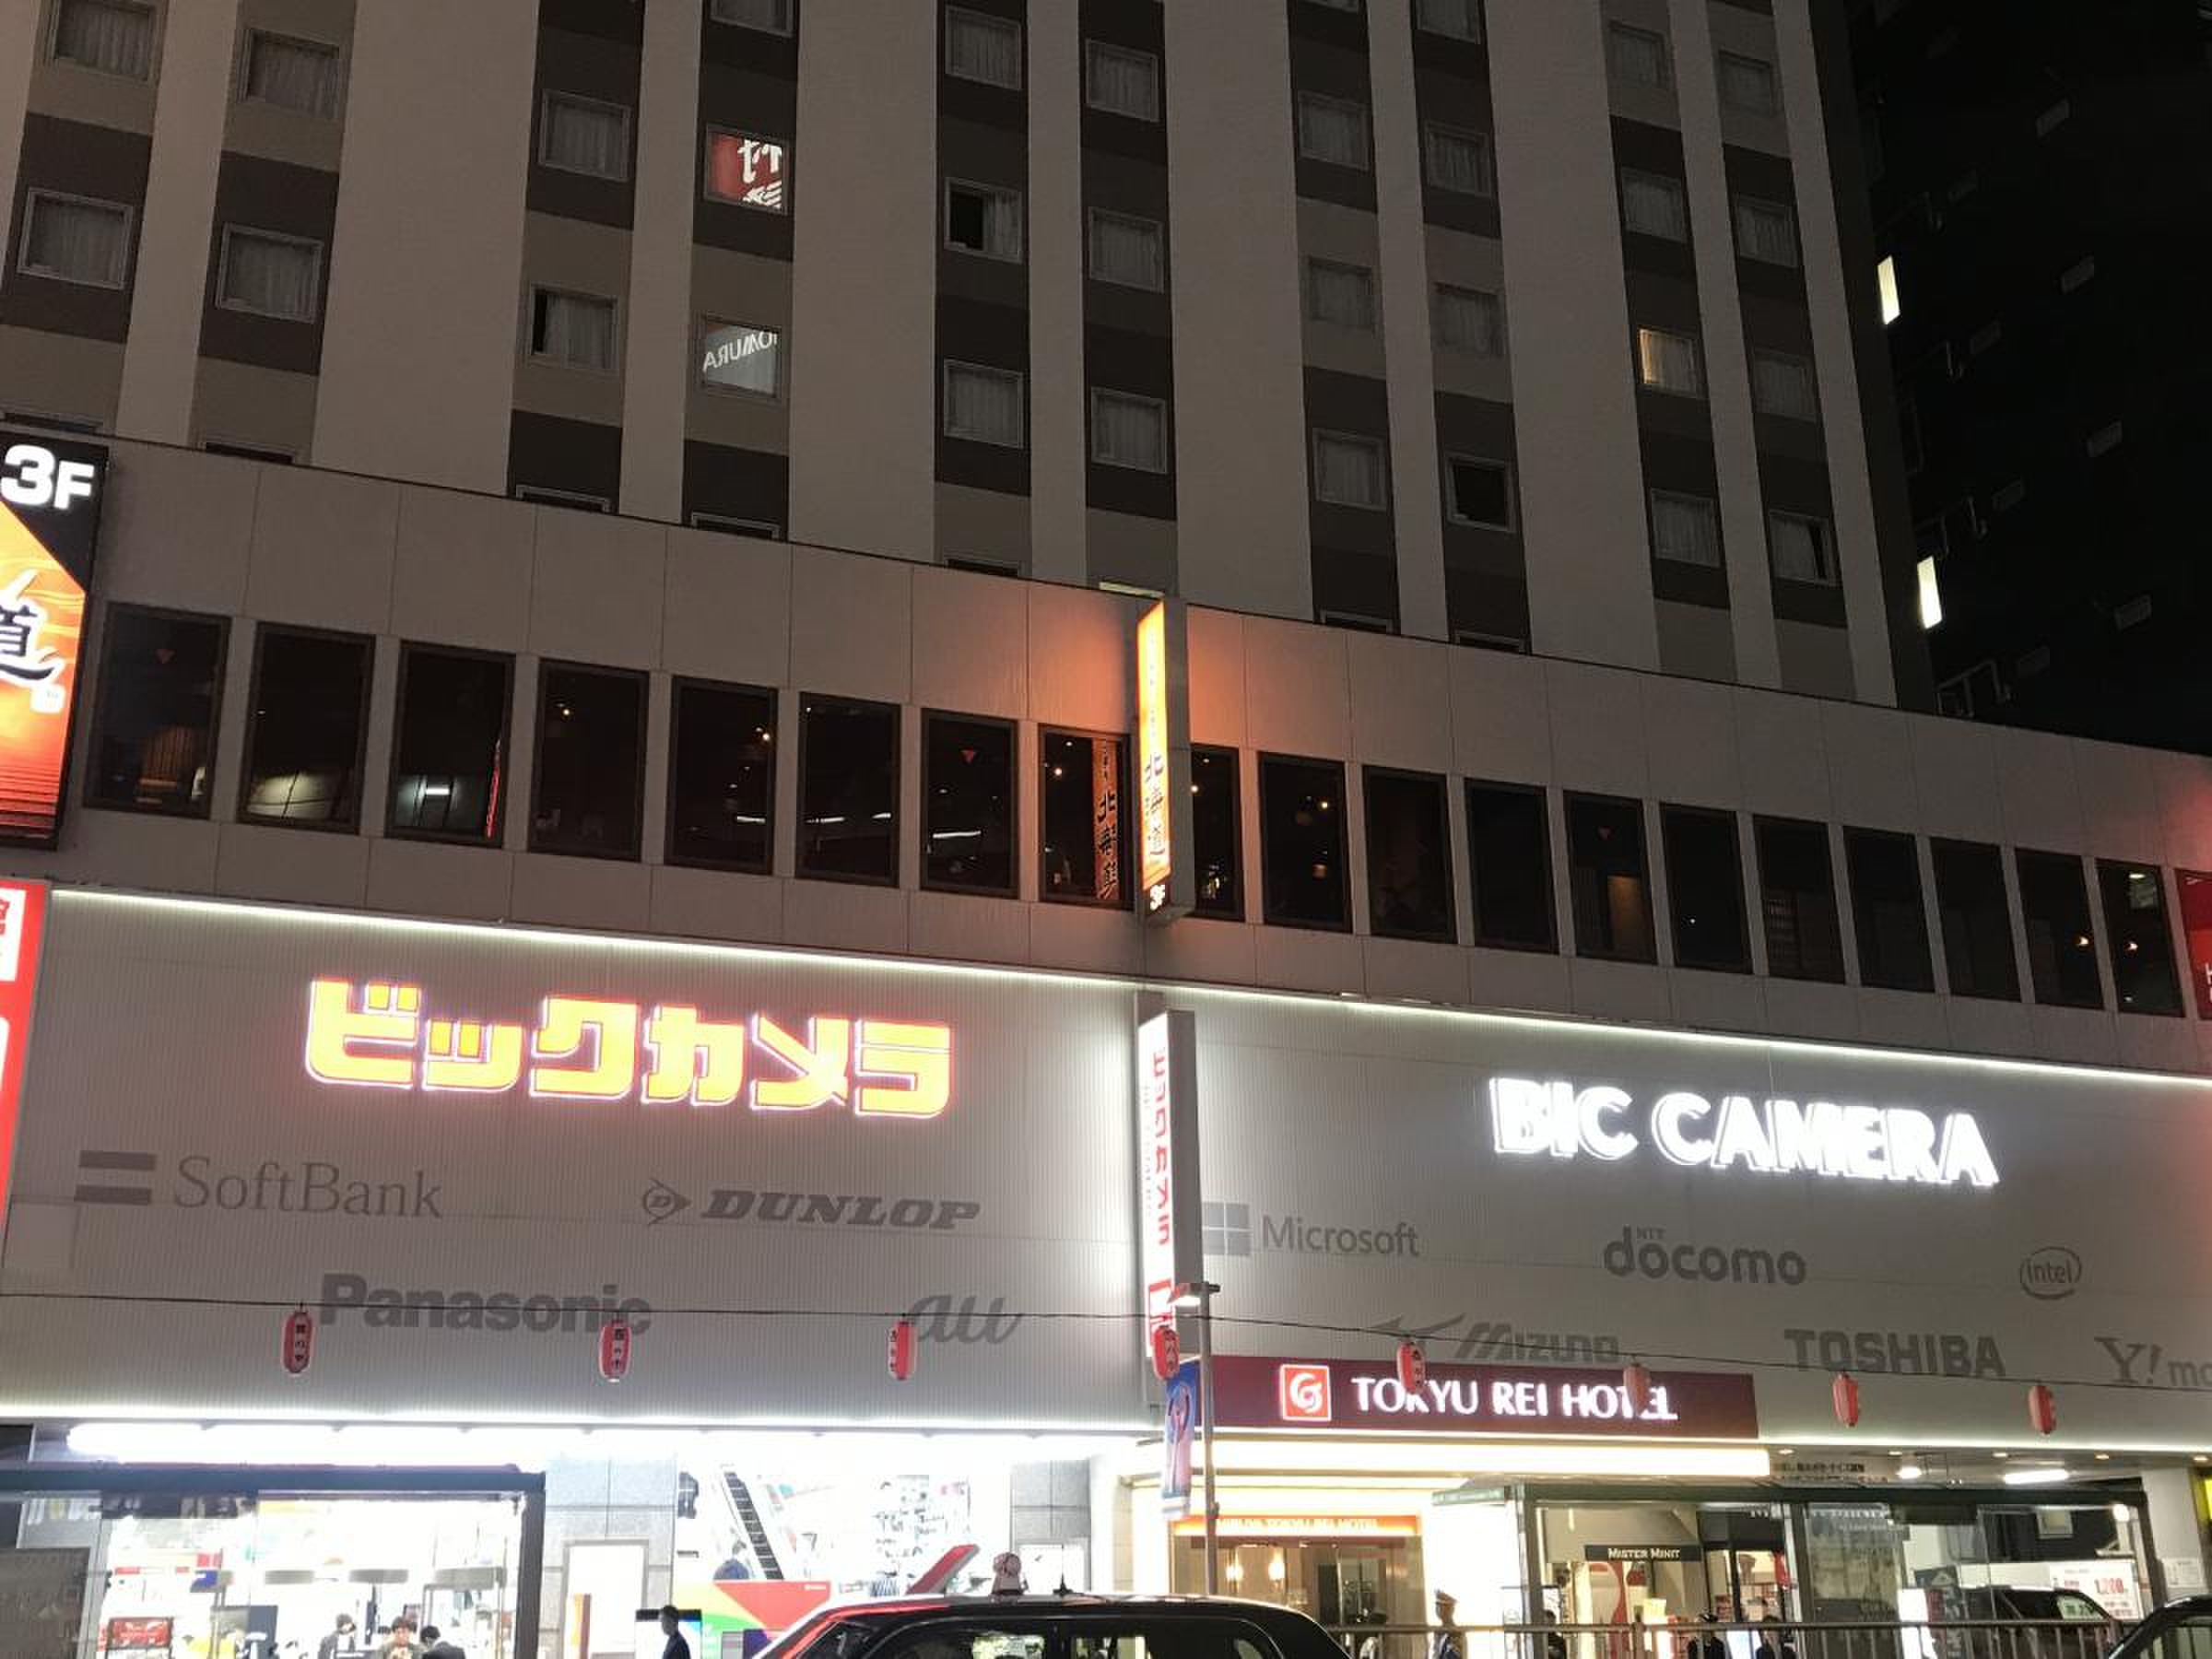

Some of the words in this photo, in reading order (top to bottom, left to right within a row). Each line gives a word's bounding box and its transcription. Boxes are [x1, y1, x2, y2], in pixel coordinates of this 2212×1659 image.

[1, 445, 94, 510] 3F
[306, 979, 954, 1120] ビックカメラ
[1488, 1077, 1637, 1159] BIC
[1650, 1090, 2001, 1187] CAMERA
[173, 1155, 442, 1218] SoftBank
[700, 1190, 980, 1229] DUNLOP
[1263, 1215, 1419, 1257] Microsoft
[1604, 1227, 1806, 1285] docomo
[1637, 1227, 1665, 1239] NTT
[2027, 1260, 2072, 1285] intel
[321, 1274, 651, 1336] Panasonic
[908, 1293, 1023, 1344] au
[1784, 1329, 2005, 1377] TOSHIBA
[1491, 1380, 1547, 1417] REI
[1562, 1385, 1678, 1421] HOTEL
